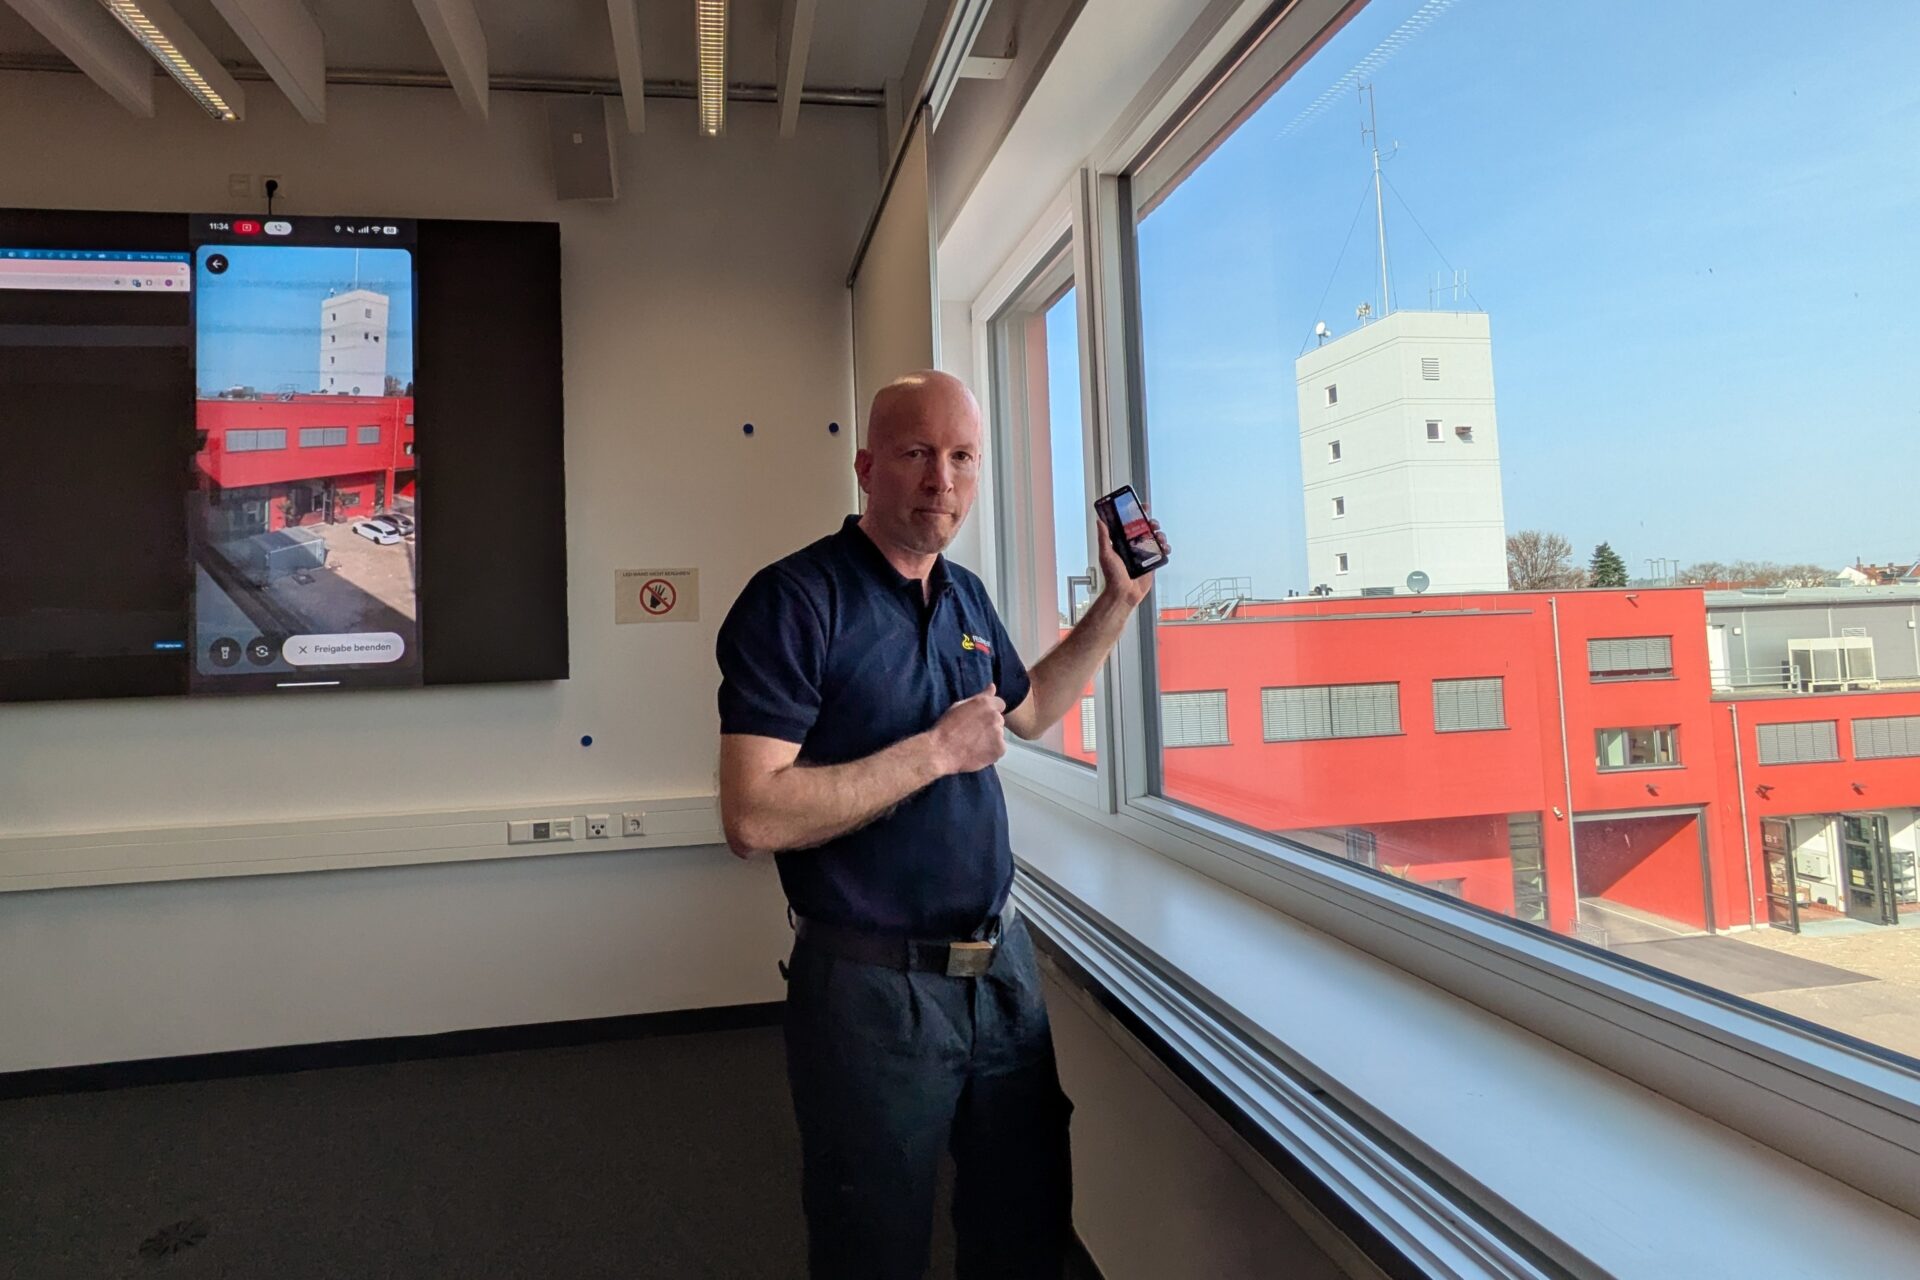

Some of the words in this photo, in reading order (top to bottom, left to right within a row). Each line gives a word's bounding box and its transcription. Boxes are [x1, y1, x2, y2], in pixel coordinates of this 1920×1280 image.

[209, 222, 229, 231] 11:34
[314, 644, 352, 655] Freigabe
[354, 643, 391, 652] beenden
